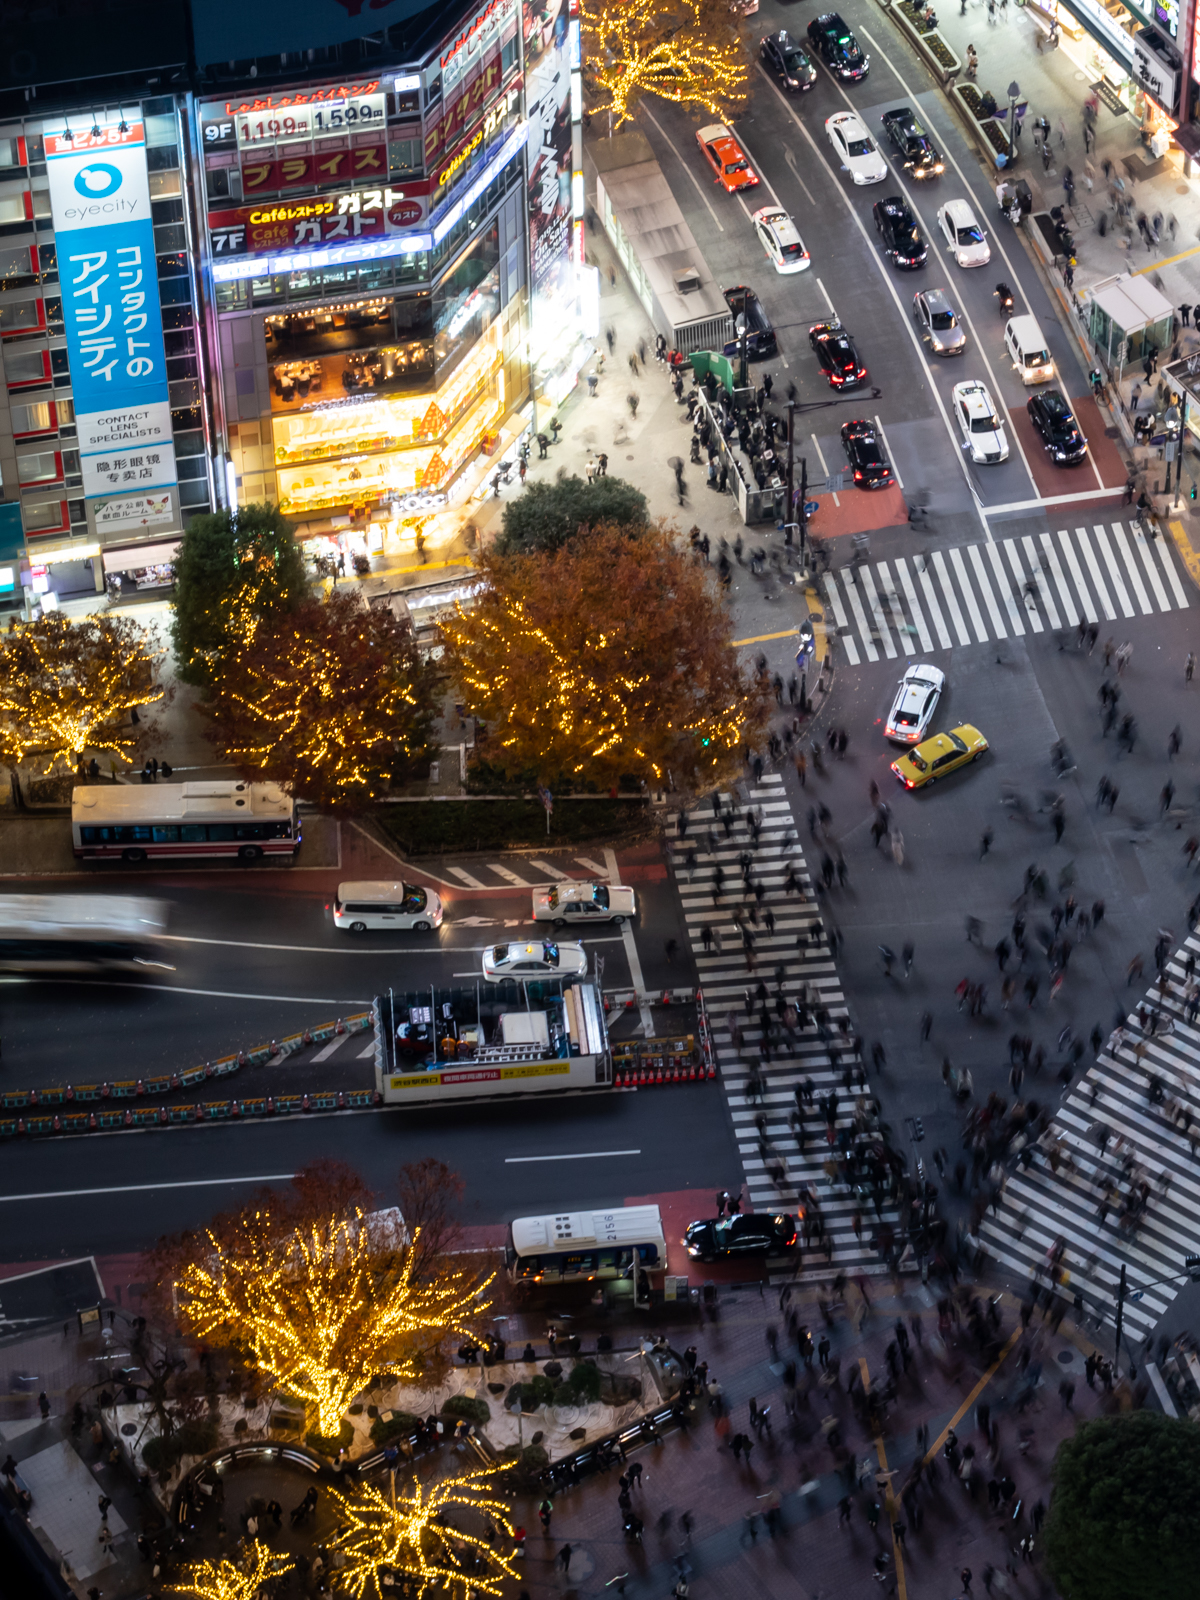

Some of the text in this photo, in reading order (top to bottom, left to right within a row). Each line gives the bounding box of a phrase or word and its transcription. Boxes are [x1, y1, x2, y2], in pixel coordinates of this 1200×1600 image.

[225, 80, 380, 116] しゃぶしゃぶバイキング
[314, 104, 383, 132] 1,599円
[484, 89, 518, 139] ガスト
[205, 123, 232, 141] 9F
[241, 117, 307, 144] 1,199円
[244, 149, 382, 187] プライス
[64, 199, 138, 221] eyecity
[338, 188, 404, 216] ガスト
[392, 209, 420, 221] ガスト
[212, 232, 244, 251] 7F
[252, 225, 289, 240] Café
[294, 213, 377, 246] ガスト
[535, 220, 569, 260] On Sale
[69, 251, 119, 382] アイシティ
[116, 246, 154, 378] コンタクトの
[97, 411, 149, 426] CONTACT
[110, 422, 138, 433] LENS
[89, 427, 161, 444] SPECIALISTS
[96, 454, 161, 473] 隐形眼镜
[106, 468, 153, 483] 专卖店
[604, 1215, 617, 1240] 2156
